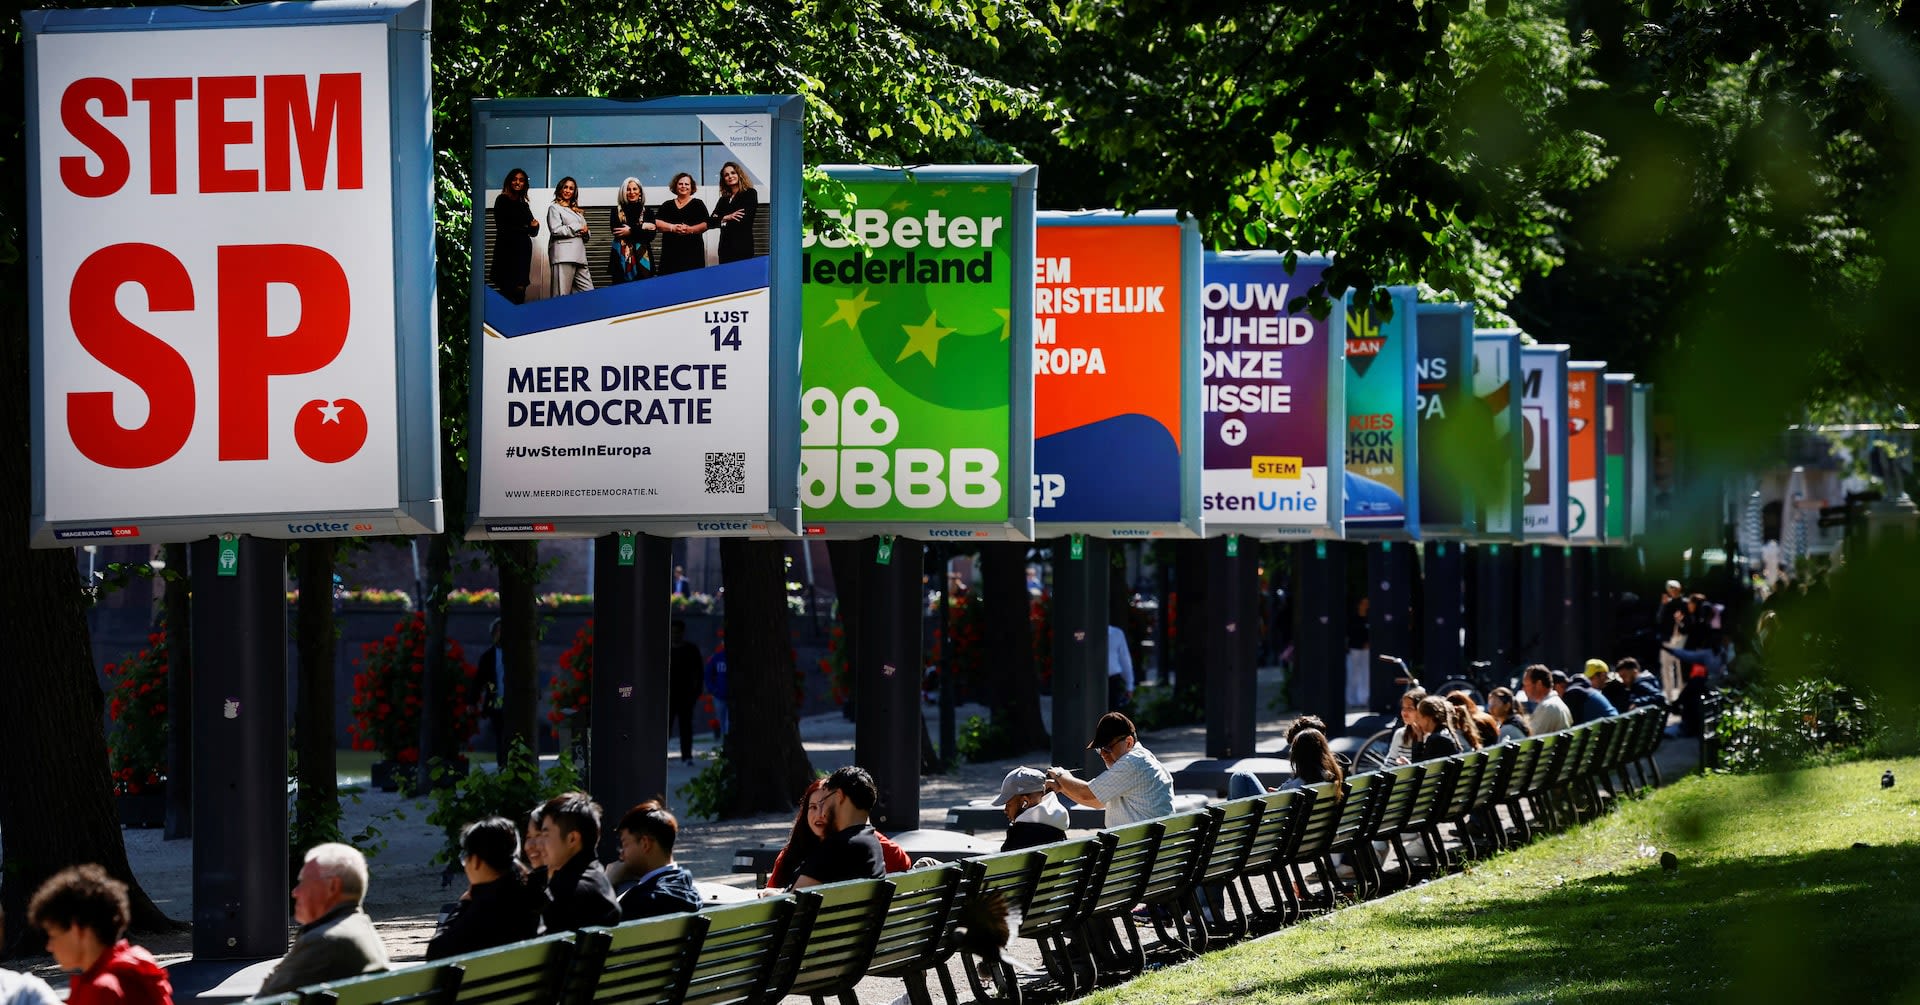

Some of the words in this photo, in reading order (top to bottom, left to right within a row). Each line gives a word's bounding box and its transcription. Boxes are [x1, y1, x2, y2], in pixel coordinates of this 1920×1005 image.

[59, 73, 363, 198] STEM
[1036, 287, 1165, 313] RISTELIJK
[1203, 283, 1289, 311] OUW
[704, 310, 749, 323] LIJST
[710, 325, 742, 351] 14
[1203, 316, 1314, 345] IJHEID
[1034, 348, 1106, 375] ROPA
[507, 366, 591, 393] MEER
[601, 364, 727, 391] DIRECTE
[507, 398, 712, 427] DEMOCRATIE
[1349, 413, 1394, 432] KIES
[1350, 431, 1393, 447] KOK
[505, 444, 652, 459] #UwStemInEuropa
[1345, 448, 1393, 465] HAN
[1258, 462, 1296, 474] STEM
[504, 488, 659, 498] WWW.MEERDIRECTEDEMOCRATIE.NL
[1203, 491, 1318, 512] stenUnie
